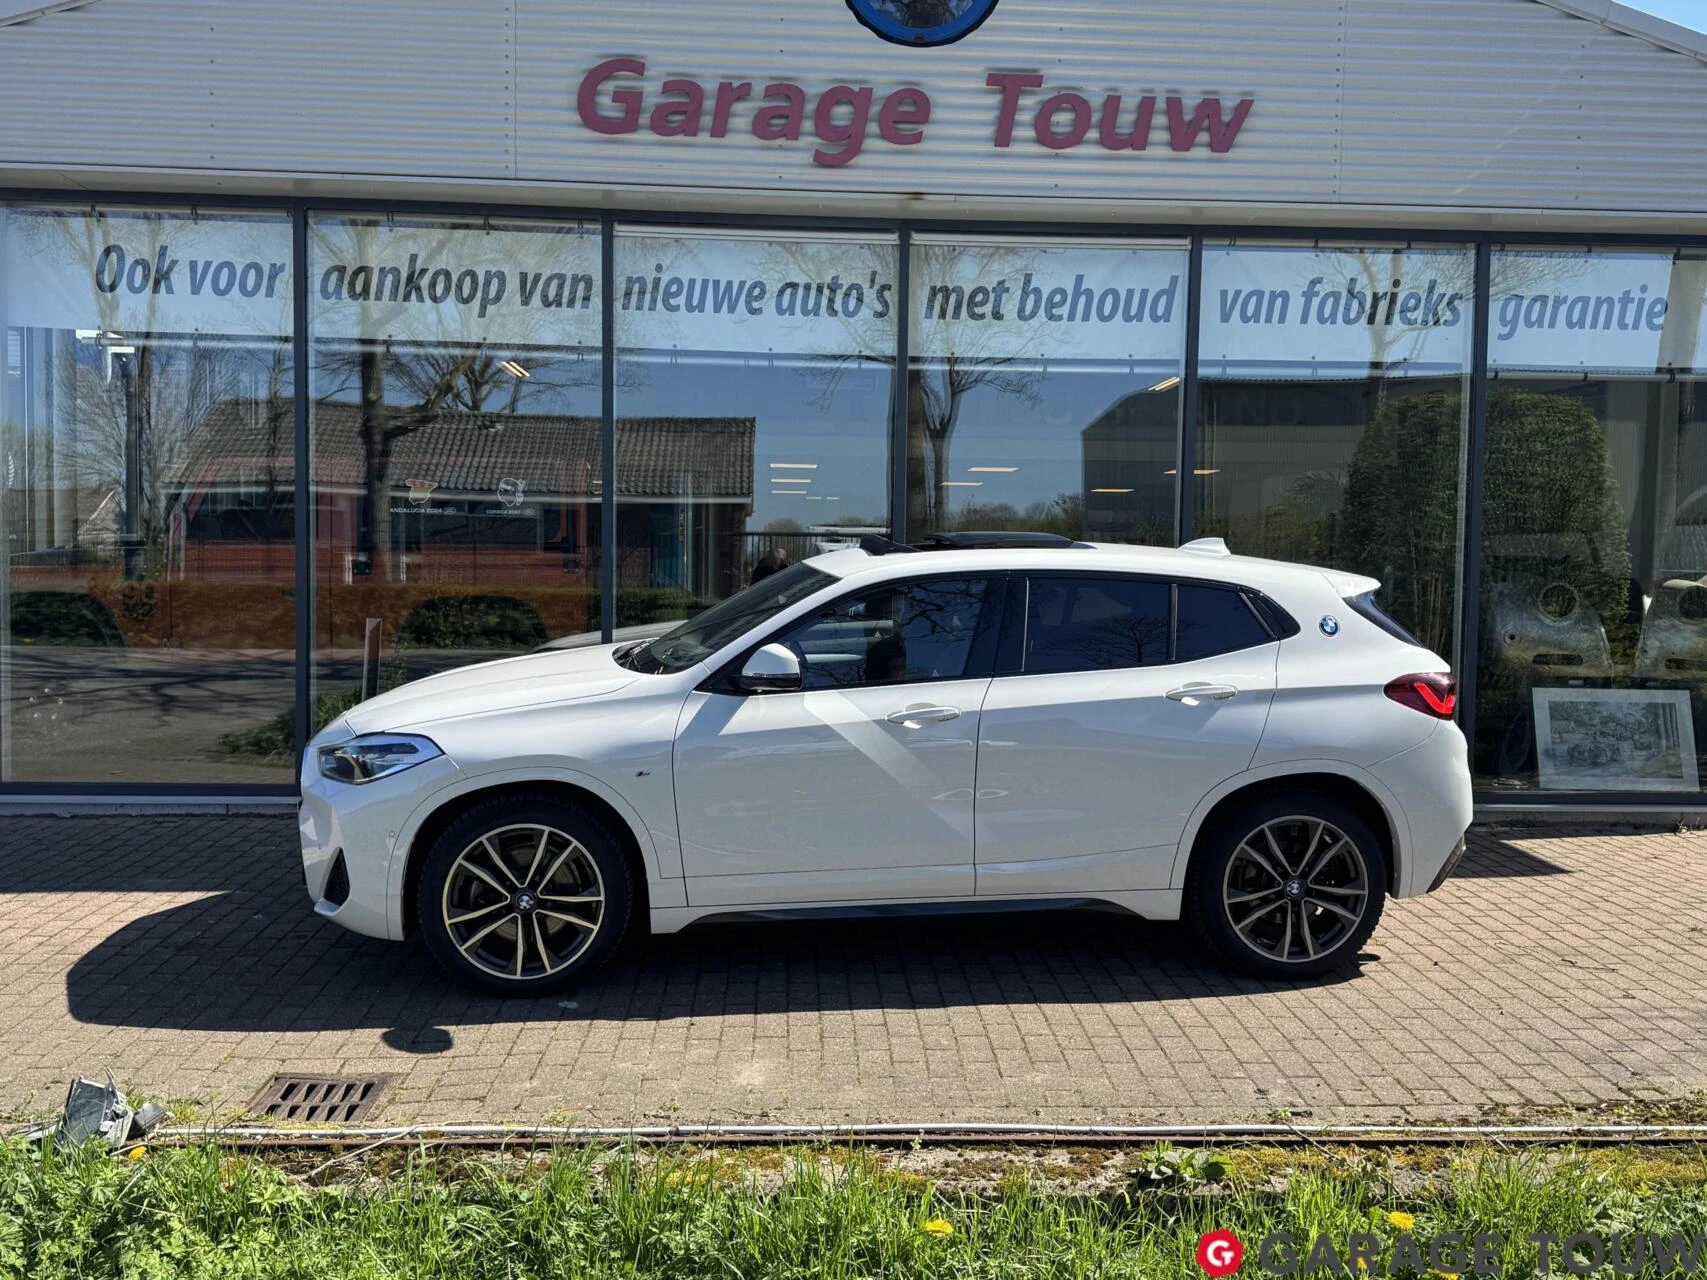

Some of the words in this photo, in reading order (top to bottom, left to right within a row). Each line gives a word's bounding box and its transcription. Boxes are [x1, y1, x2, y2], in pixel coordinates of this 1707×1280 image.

[577, 57, 932, 168] Garage
[985, 72, 1255, 154] Touw
[95, 244, 179, 295] Ook
[188, 259, 287, 299] voor
[319, 253, 507, 319] aankoop
[518, 271, 594, 310] van
[621, 262, 767, 316] nieuwe
[774, 270, 893, 319] auto's
[923, 278, 1010, 321] met
[1016, 272, 1180, 323] behoud
[1218, 288, 1291, 325] van
[1299, 276, 1464, 327] fabrieks
[1497, 283, 1669, 342] garantie
